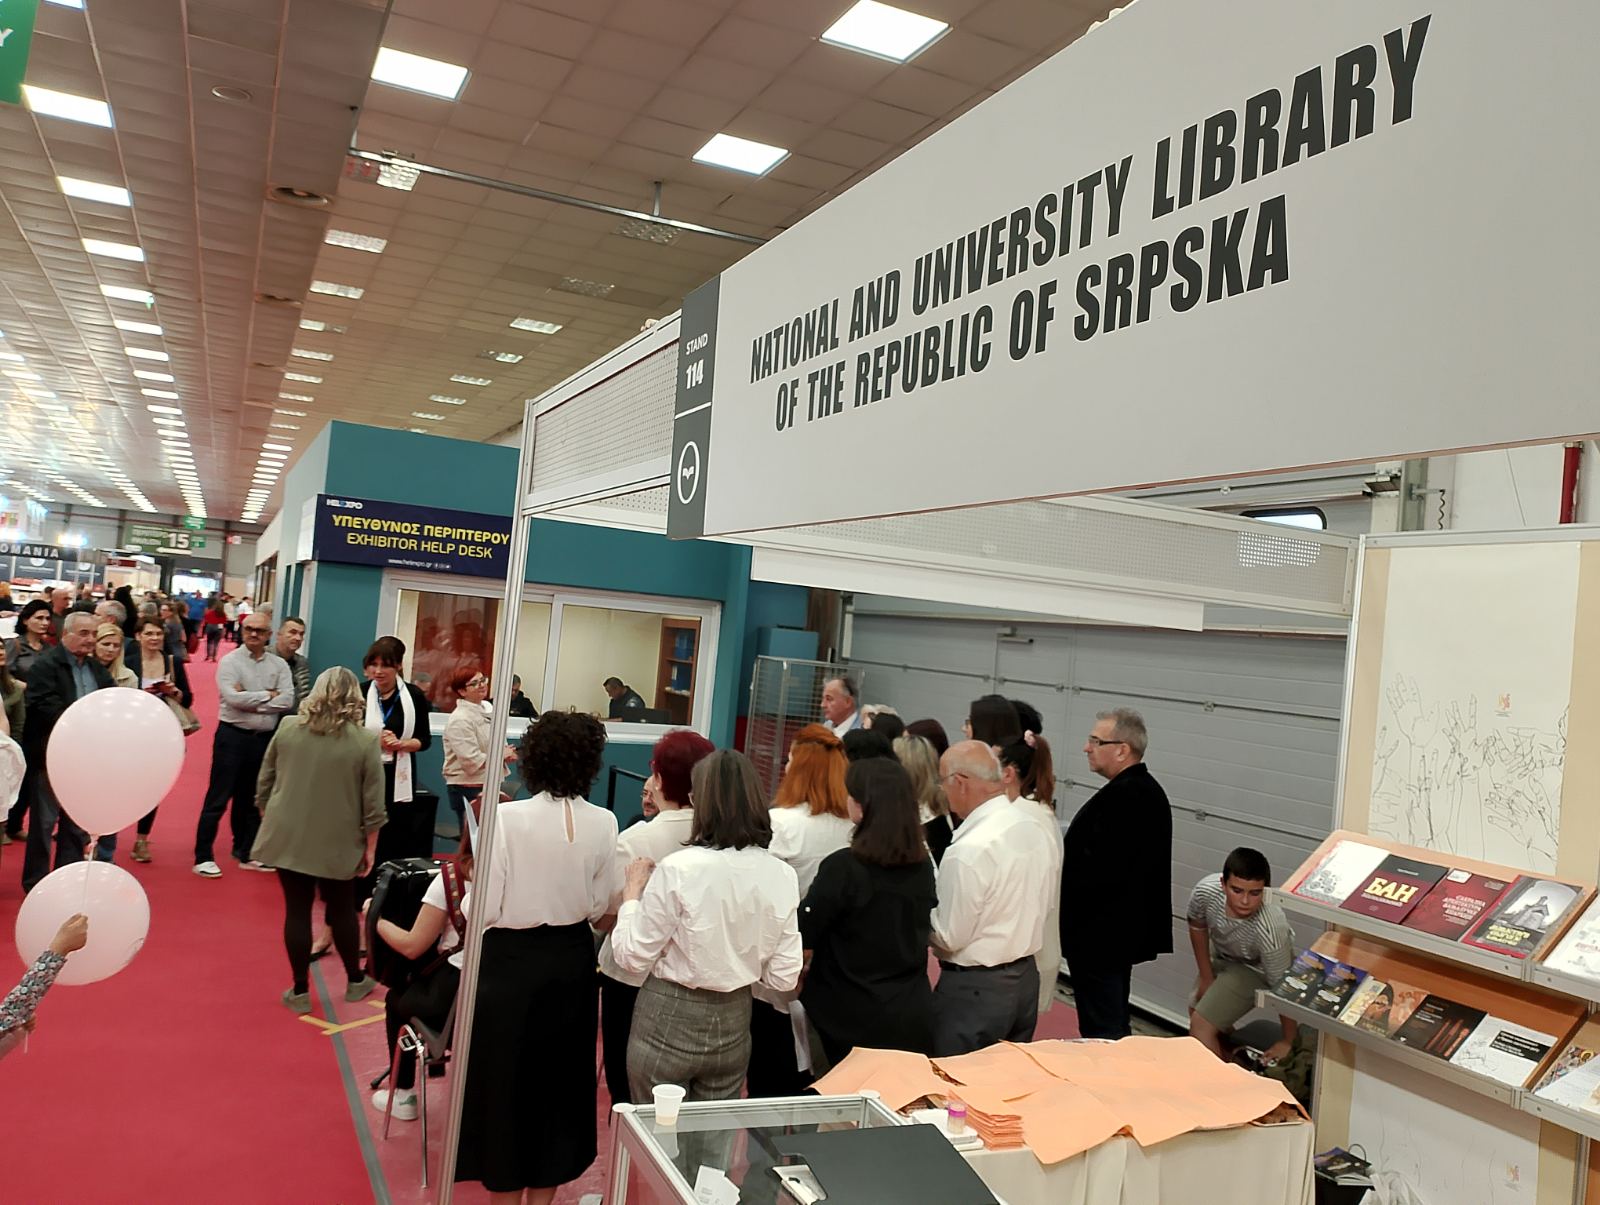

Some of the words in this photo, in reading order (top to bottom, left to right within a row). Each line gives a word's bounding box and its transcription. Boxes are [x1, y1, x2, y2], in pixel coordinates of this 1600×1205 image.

[750, 299, 840, 384] NATIONAL
[848, 270, 901, 343] AND
[912, 155, 1134, 316] UNIVERSITY
[1152, 14, 1432, 220] LIBRARY
[776, 378, 800, 432] OF
[808, 361, 846, 422] THE
[853, 305, 993, 408] REPUBLIC
[1010, 280, 1058, 361] OF
[1074, 195, 1289, 342] SRPSKA
[685, 333, 709, 356] STAND
[685, 359, 705, 390] 114
[168, 532, 190, 549] 15
[332, 515, 421, 535] ΥΠΕΥΘΥΝΟΣ
[423, 524, 510, 545] ΠΕΡΙΠΤΕΡΟΥ
[346, 533, 418, 551] EXHIBITOR
[420, 541, 456, 555] HELP
[458, 545, 493, 559] DESK
[1364, 877, 1420, 903] БАН
